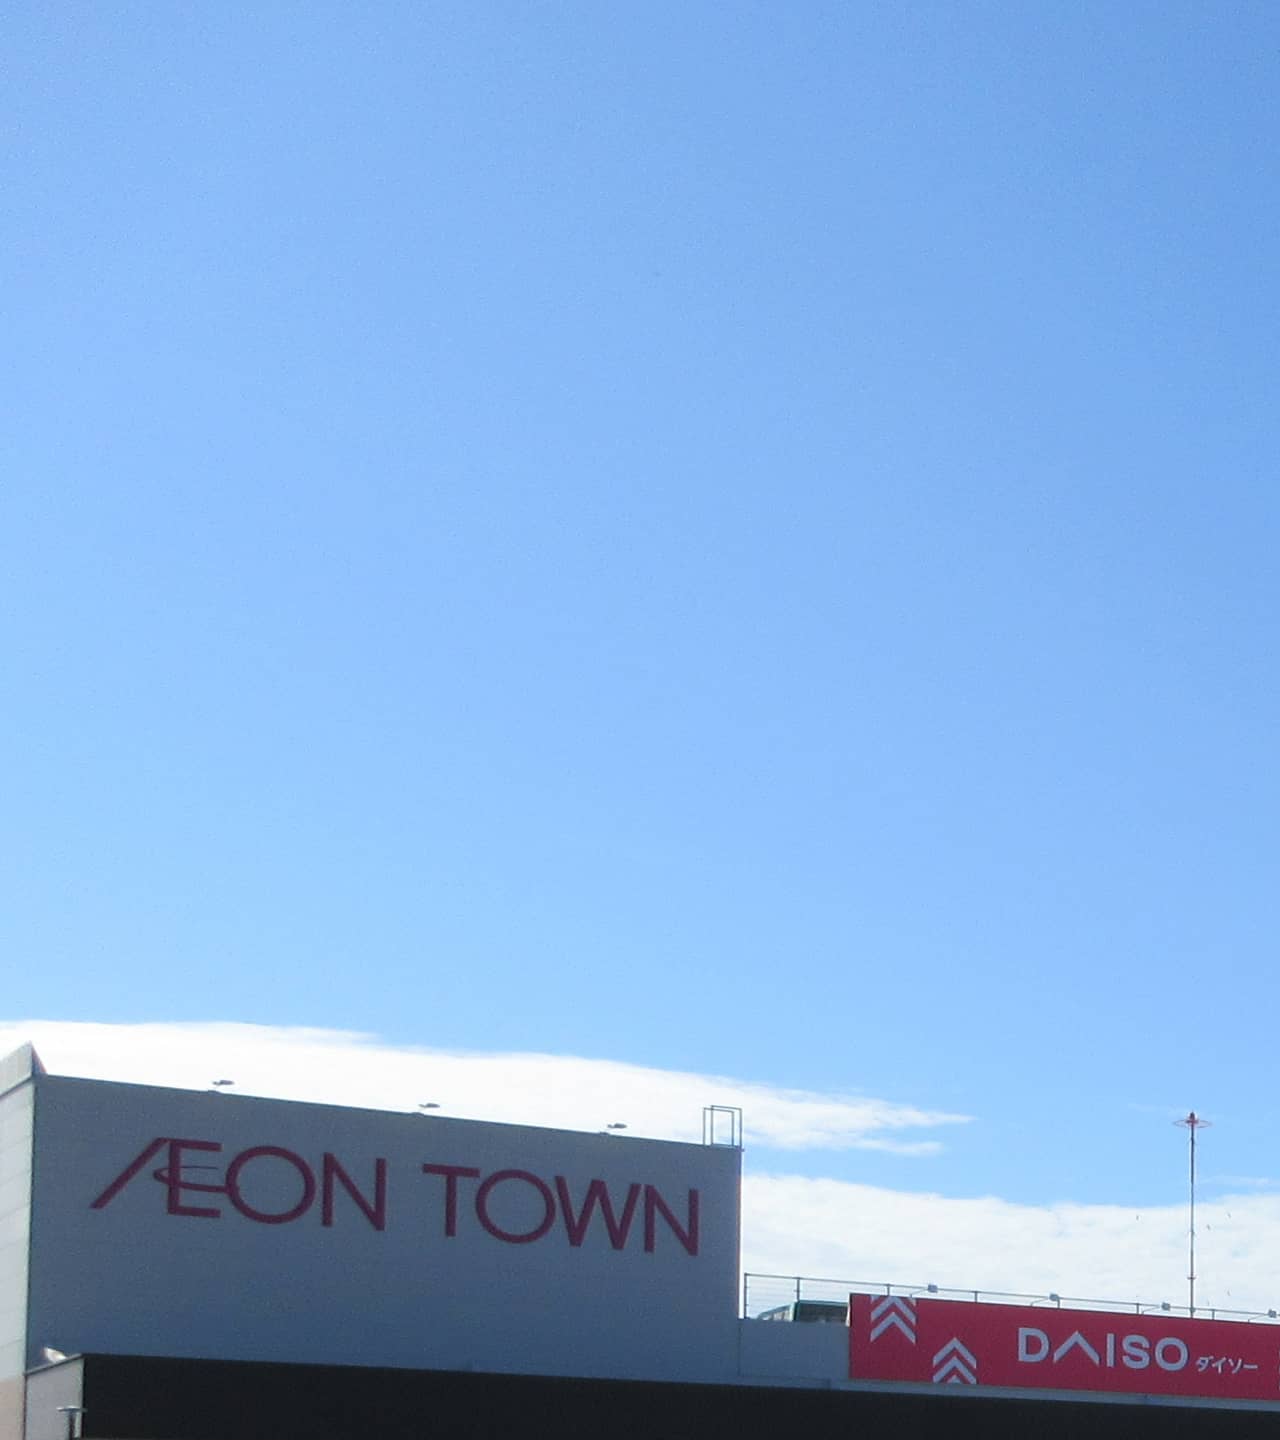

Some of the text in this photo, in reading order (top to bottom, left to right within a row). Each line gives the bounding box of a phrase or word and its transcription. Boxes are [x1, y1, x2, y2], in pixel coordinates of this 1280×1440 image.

[422, 1163, 699, 1257] TOWN
[1018, 1327, 1259, 1374] DAISO ダイソー
